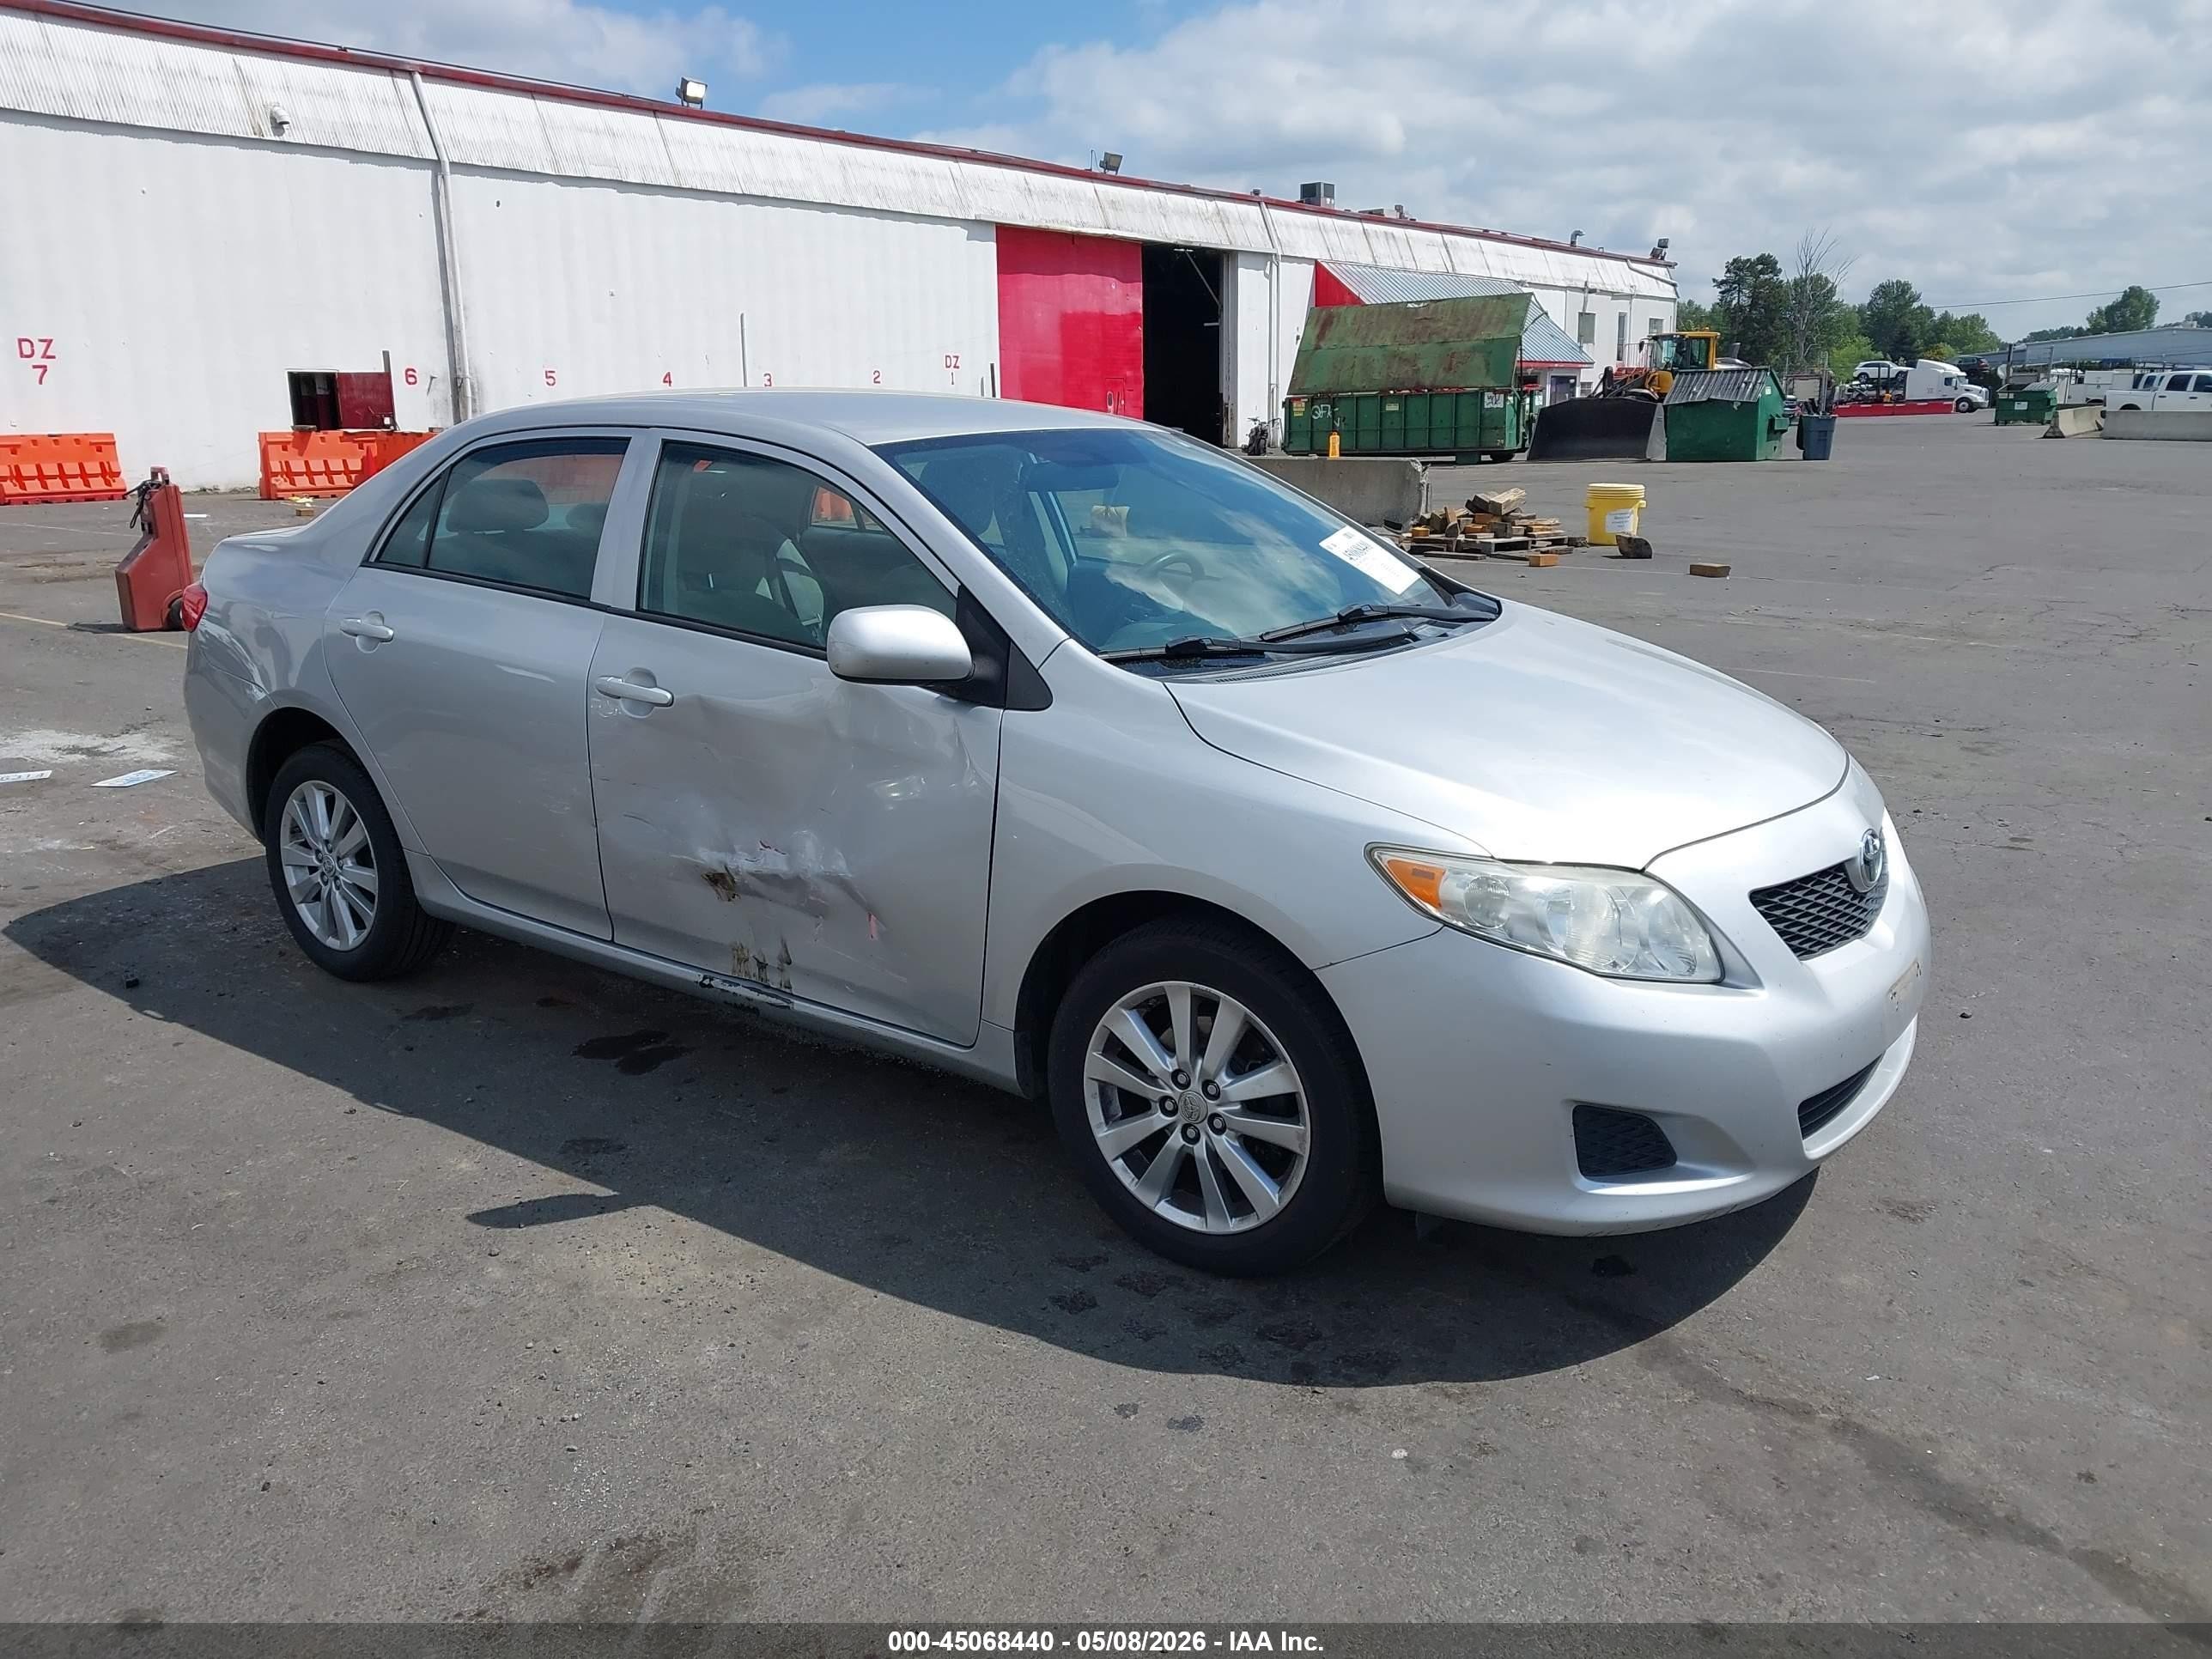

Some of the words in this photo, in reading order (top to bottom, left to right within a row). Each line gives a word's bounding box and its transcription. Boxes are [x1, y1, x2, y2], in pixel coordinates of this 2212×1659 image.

[17, 337, 56, 361] DZ
[945, 355, 960, 369] DZ
[32, 363, 49, 385] 7
[404, 367, 417, 386] 6
[544, 370, 556, 386] 5
[662, 372, 672, 386] 4
[763, 373, 772, 387] 3
[872, 370, 881, 384] 2
